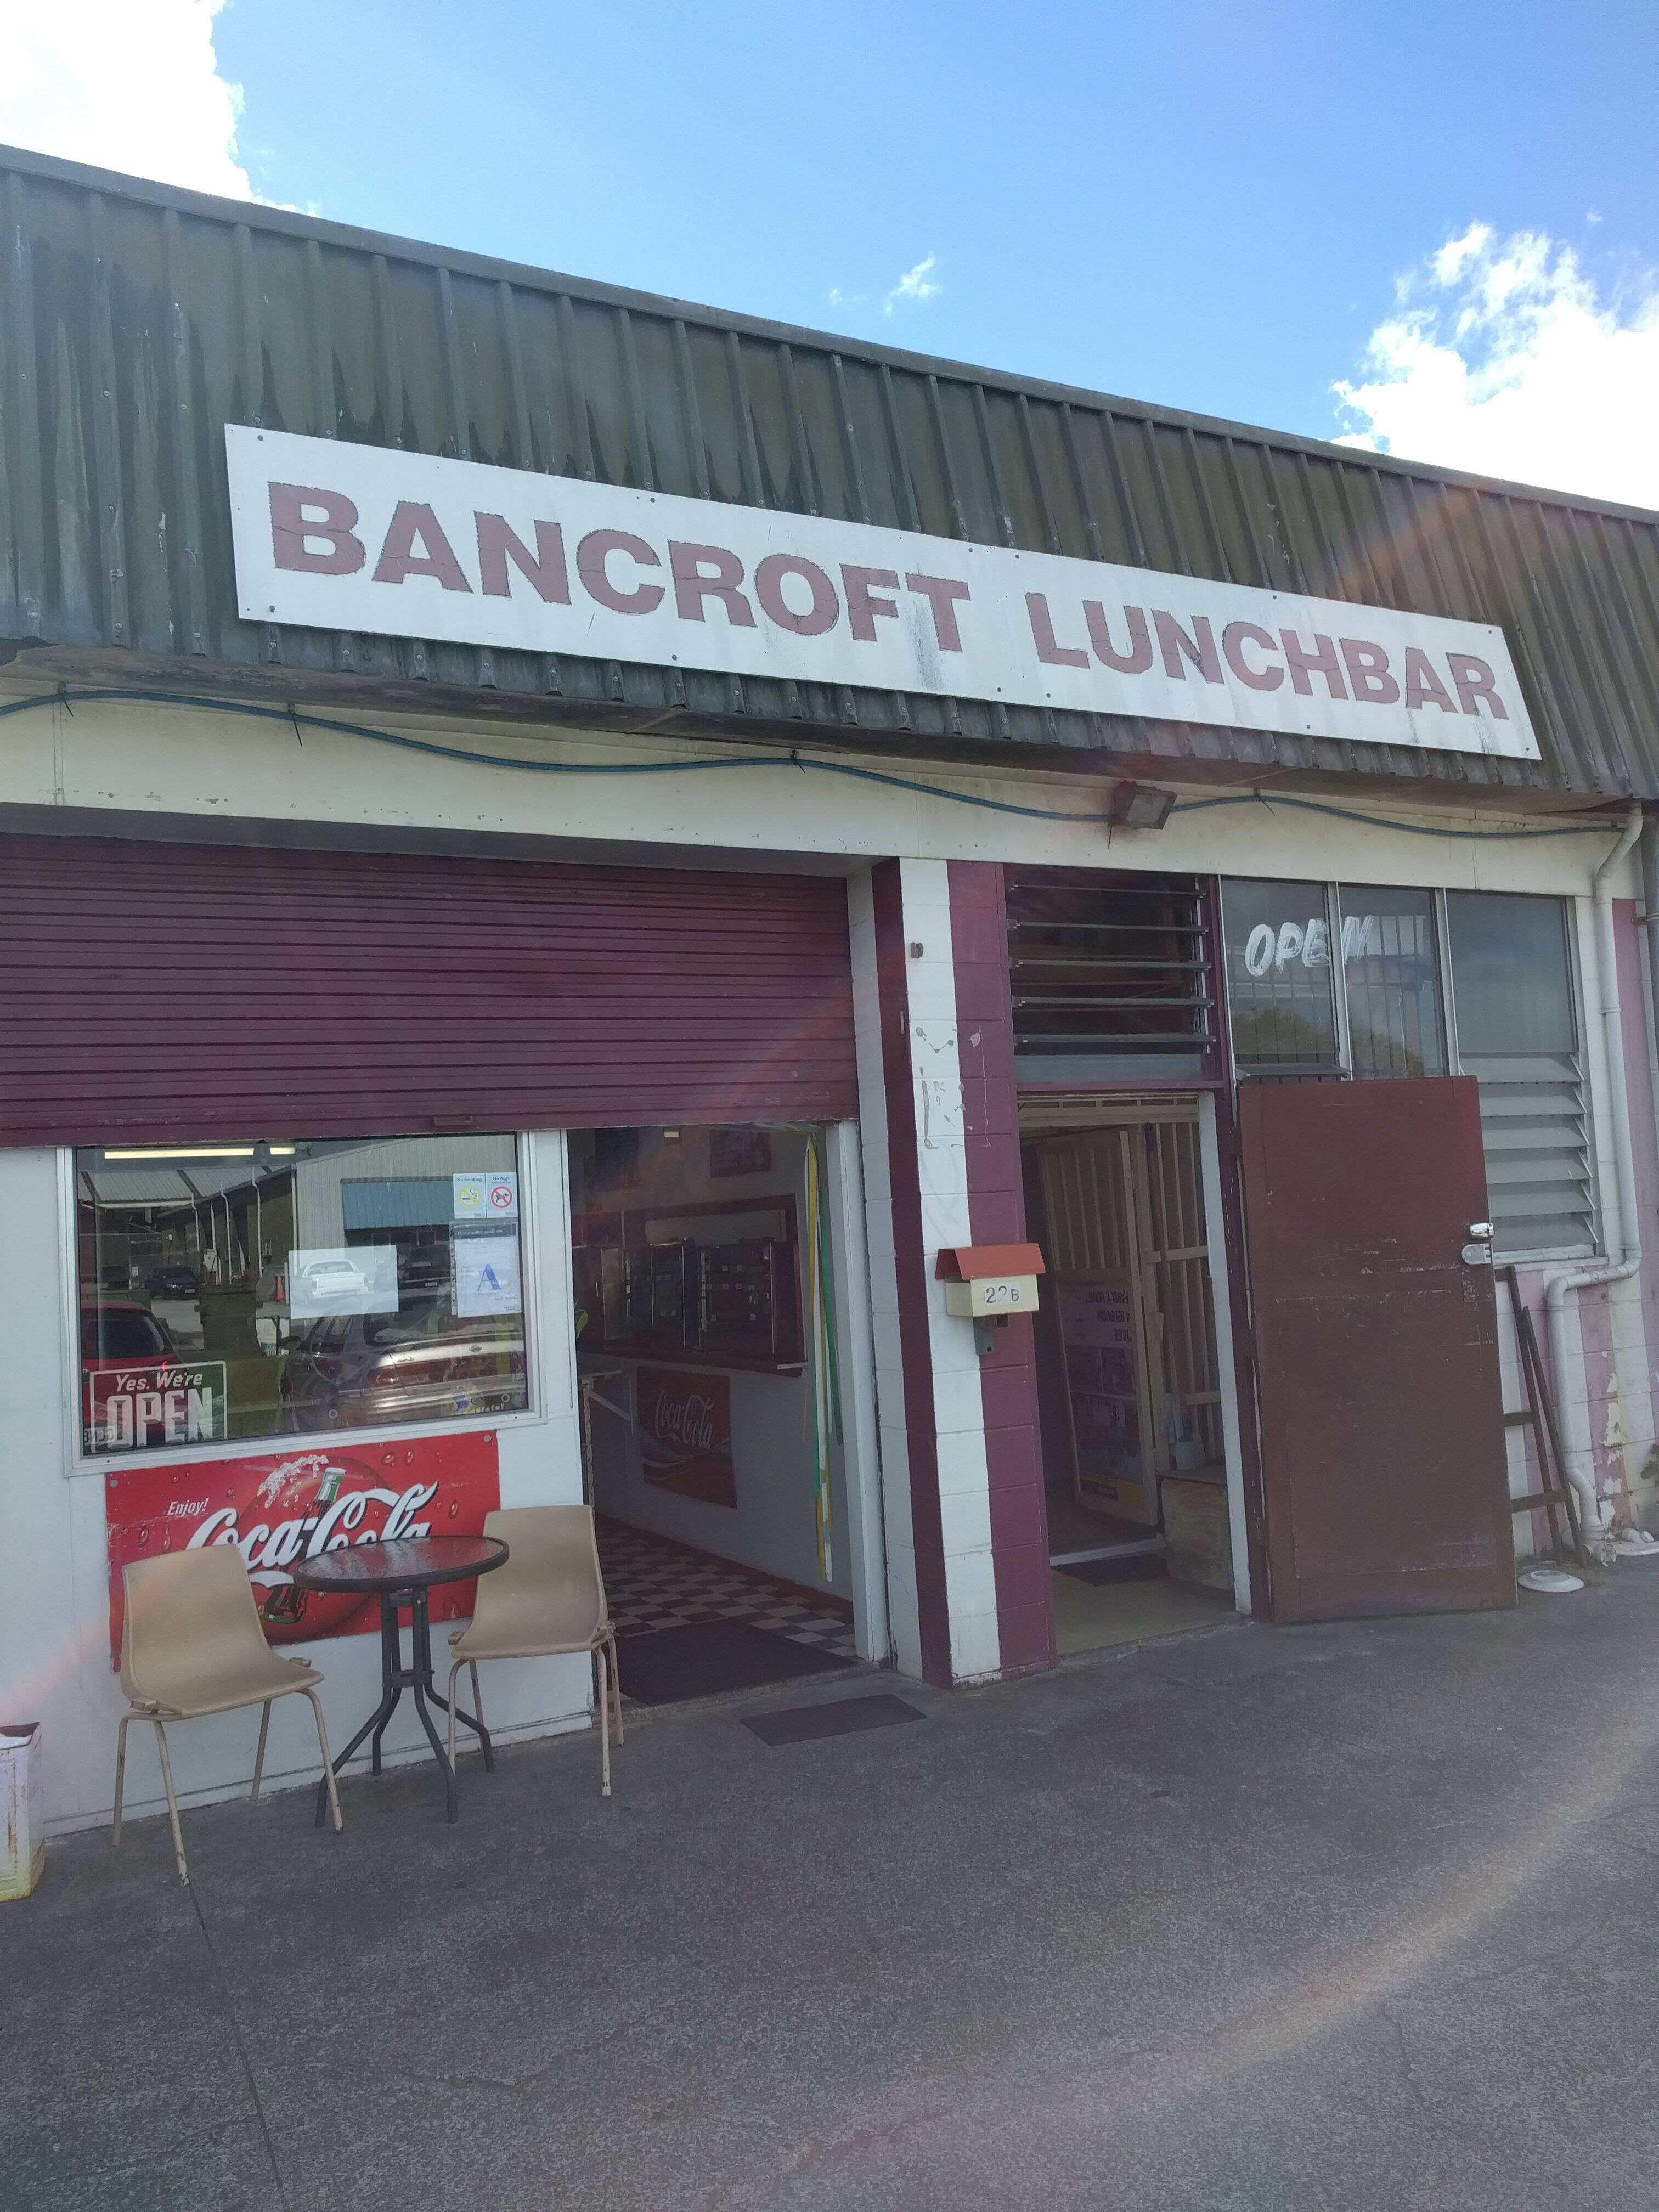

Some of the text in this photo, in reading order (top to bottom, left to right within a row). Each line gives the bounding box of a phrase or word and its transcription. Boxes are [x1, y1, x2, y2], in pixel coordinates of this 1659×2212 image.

[268, 481, 1510, 720] BANCROFT LUNCHBAR
[1245, 915, 1375, 977] OPEN
[477, 1263, 502, 1291] A
[116, 1370, 202, 1392] Yes, We're
[107, 1387, 213, 1449] OPEN
[167, 1498, 210, 1516] Enjoy!
